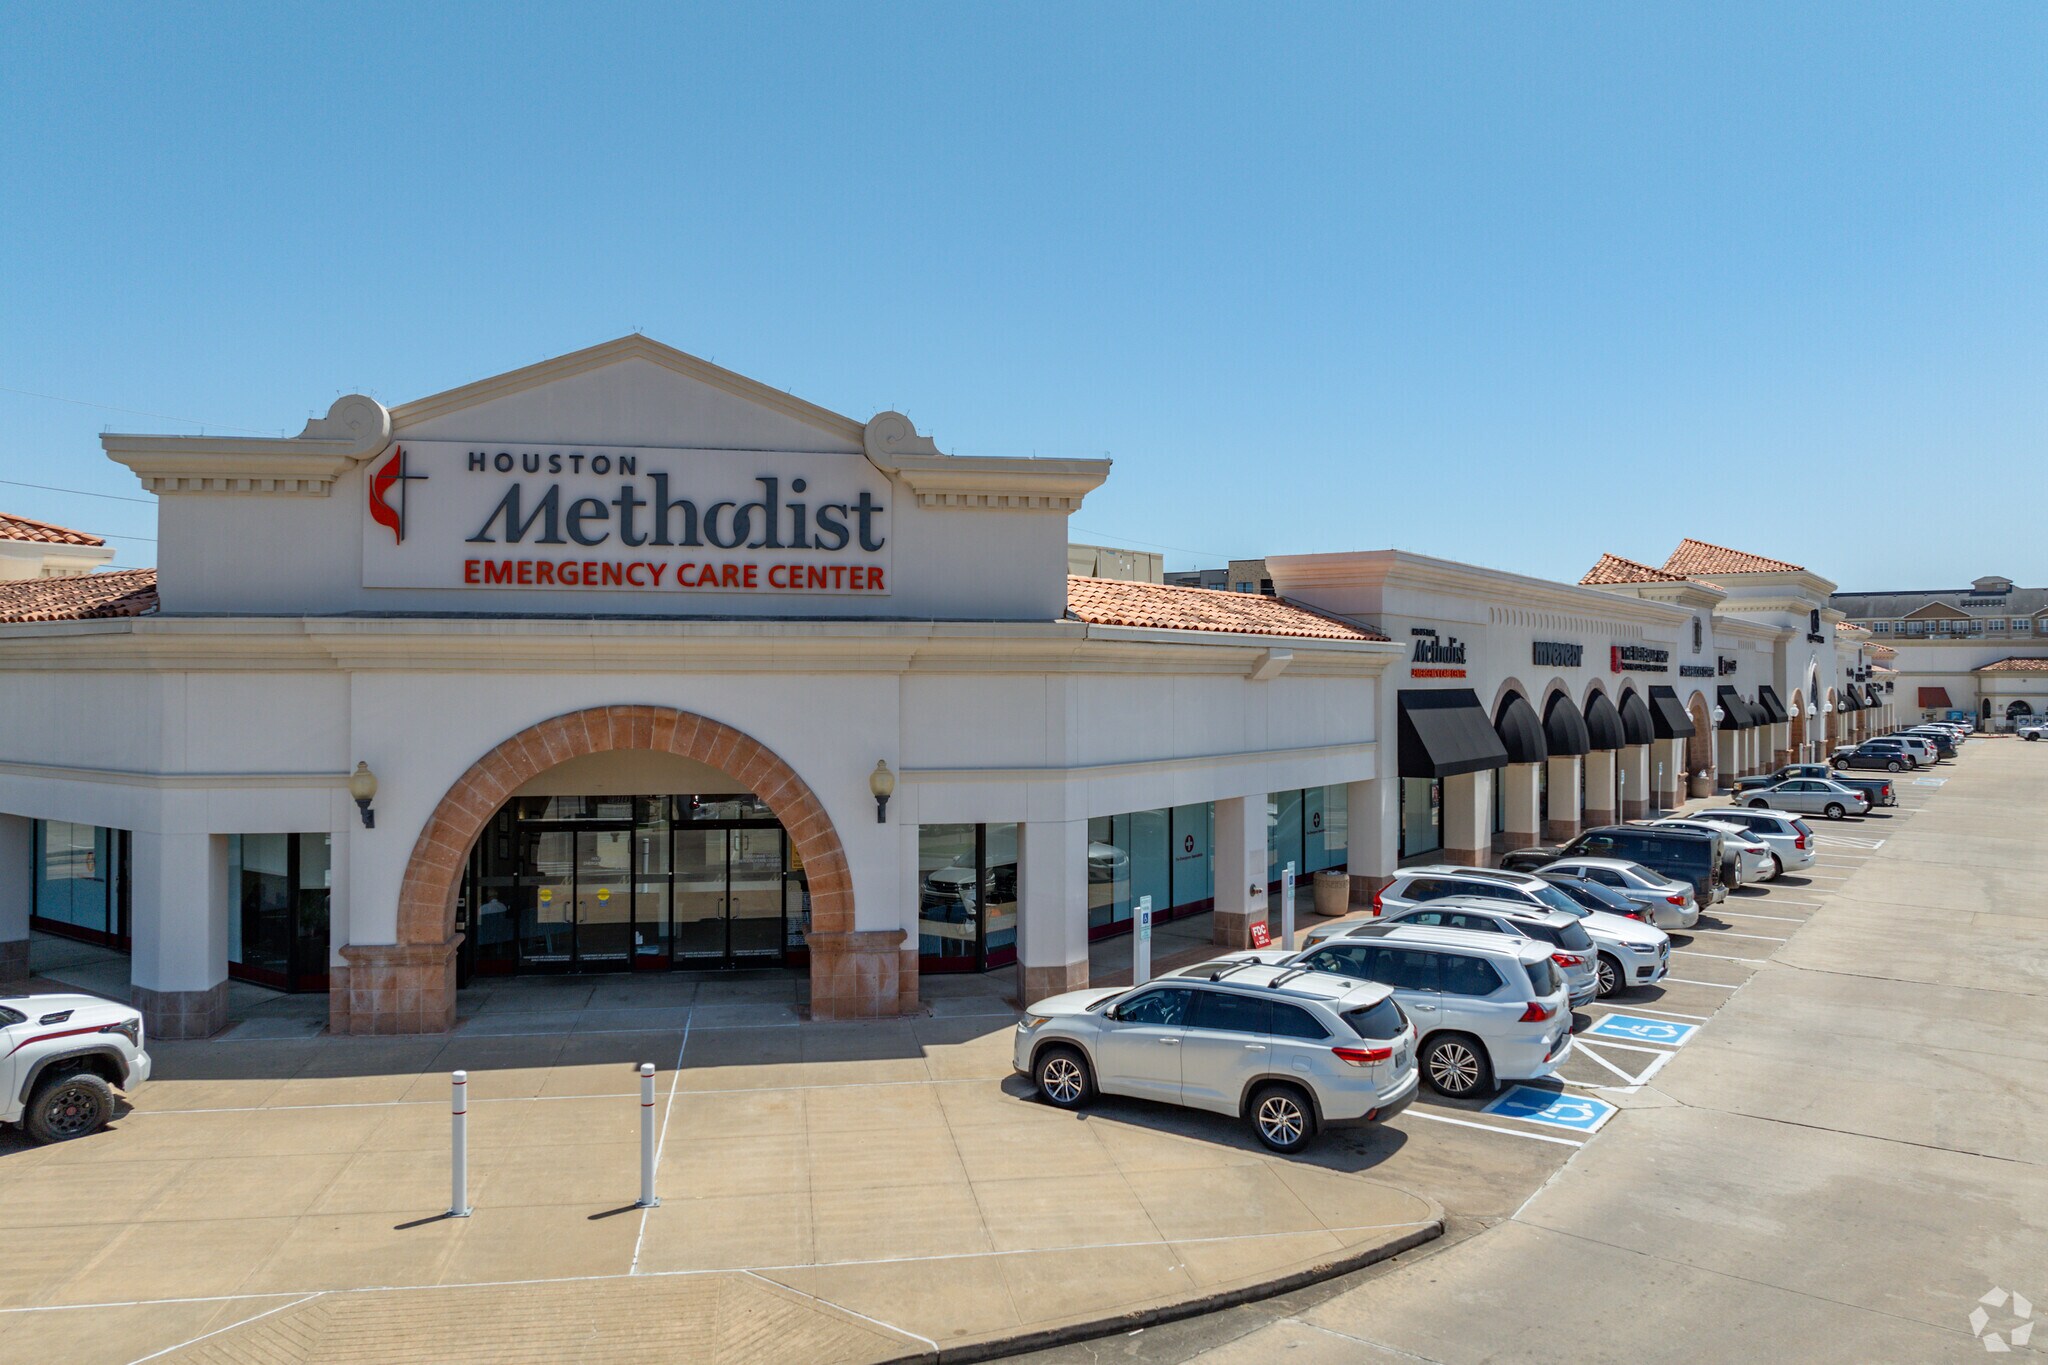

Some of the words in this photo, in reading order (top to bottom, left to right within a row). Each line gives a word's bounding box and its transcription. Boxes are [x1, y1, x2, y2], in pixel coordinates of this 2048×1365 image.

[468, 451, 637, 476] HOUSTON
[464, 472, 886, 552] Methodist
[463, 559, 668, 587] EMERGENCY
[676, 562, 759, 589] CARE
[767, 564, 886, 591] CENTER
[1411, 636, 1467, 664] Methodist
[1252, 924, 1267, 937] FDC
